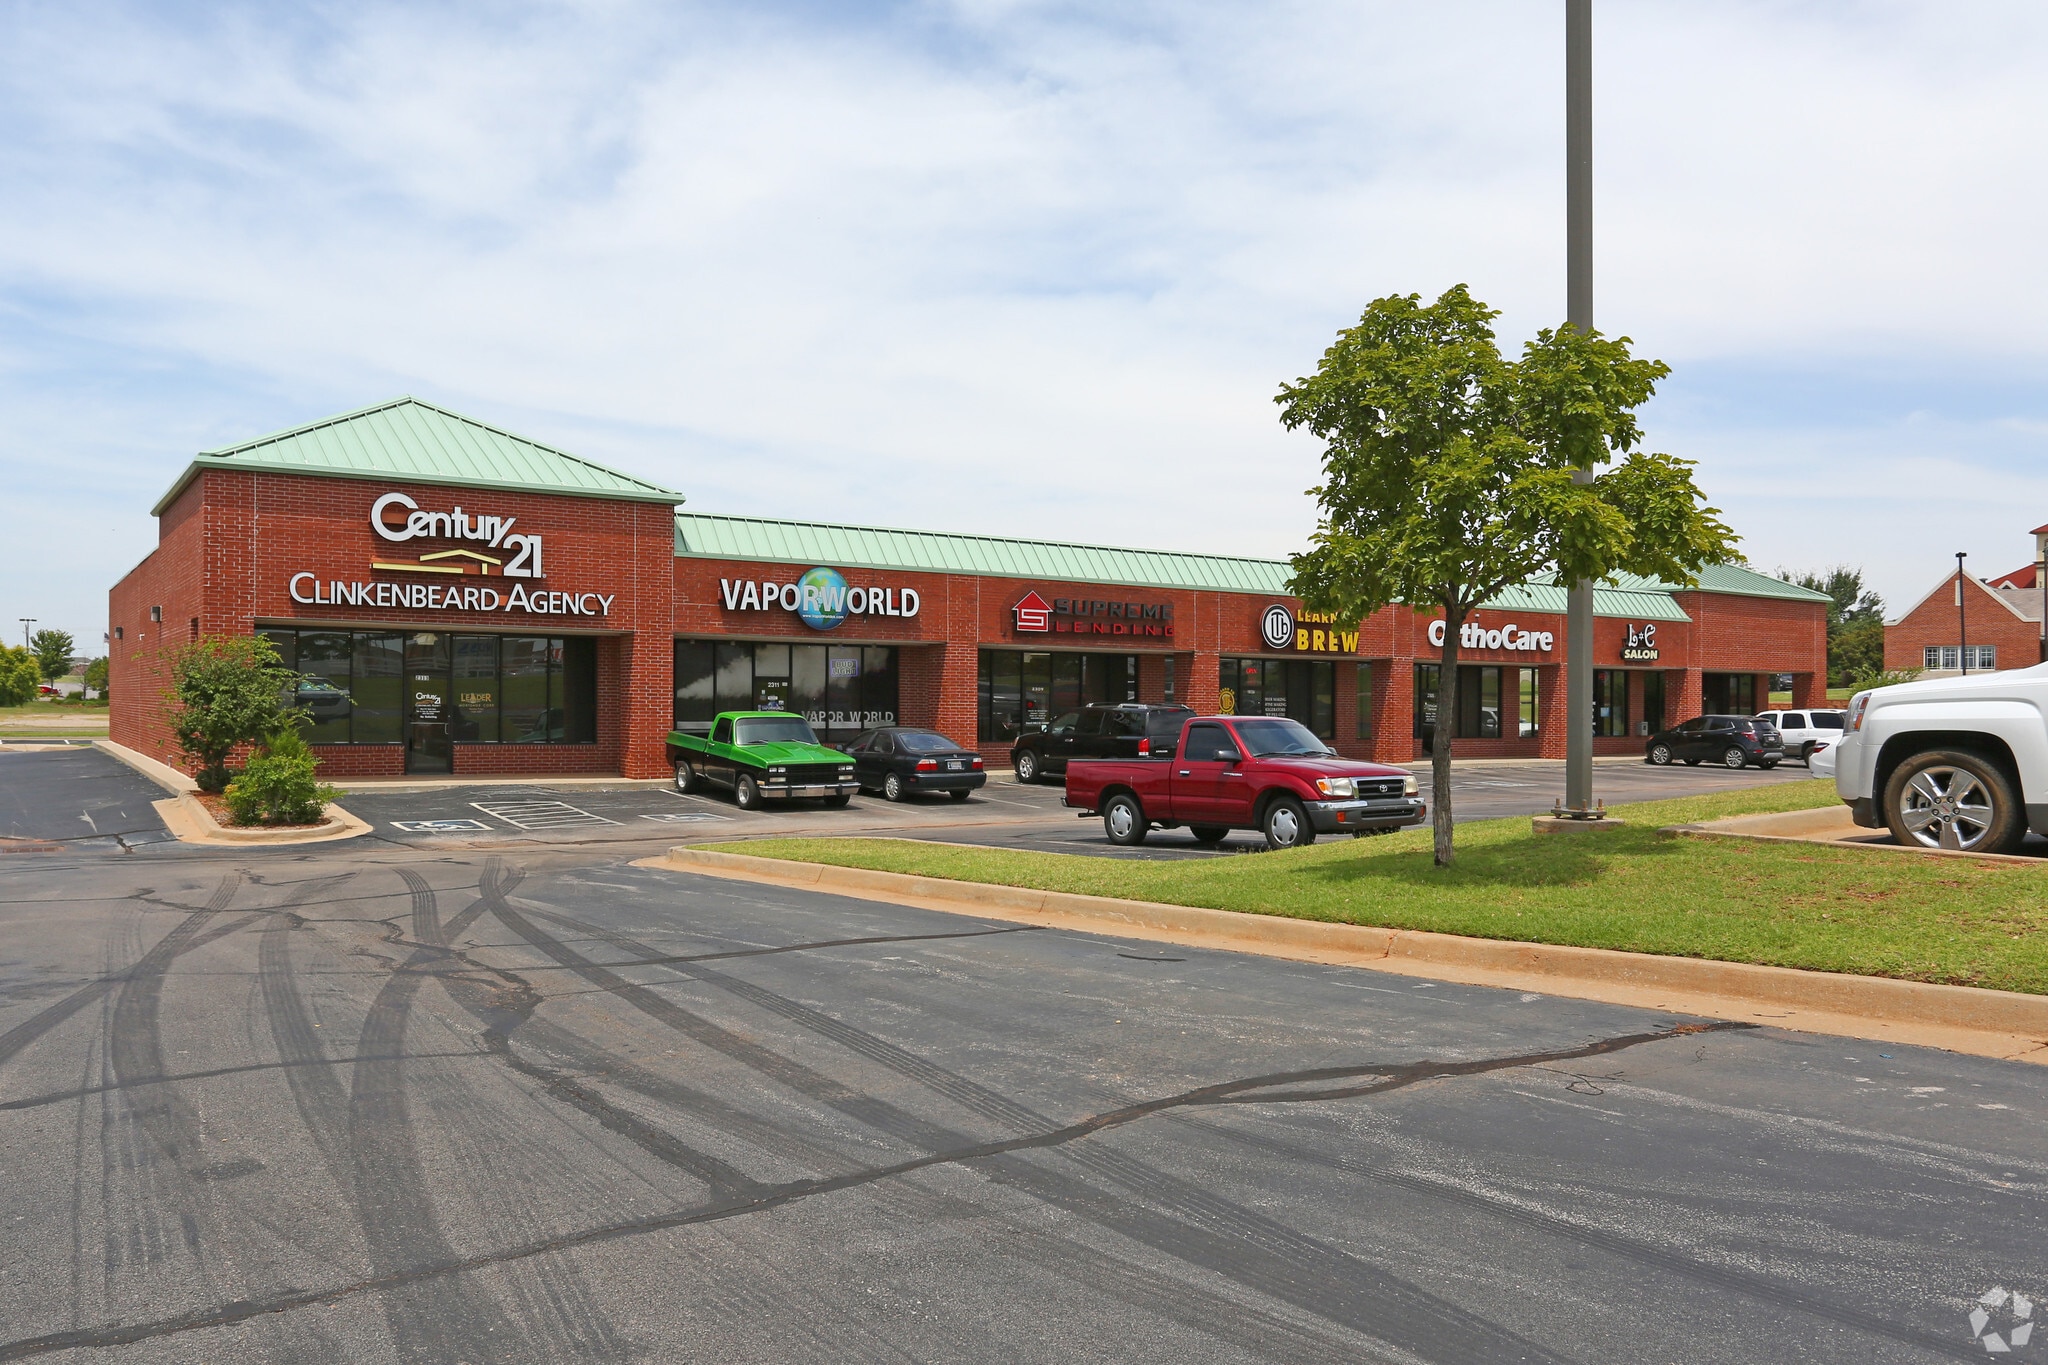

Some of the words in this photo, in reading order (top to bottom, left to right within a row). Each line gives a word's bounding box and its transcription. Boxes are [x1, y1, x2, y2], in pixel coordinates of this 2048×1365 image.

[371, 492, 516, 548] Century
[503, 533, 543, 578] 21
[289, 572, 499, 611] CLINKENBEARD
[505, 583, 615, 616] AGENCY
[1055, 599, 1174, 620] SUPREME
[1055, 621, 1175, 637] LENDING
[1297, 628, 1360, 653] BREW
[1428, 619, 1553, 652] OthoCare
[1624, 649, 1658, 660] SALON
[460, 693, 492, 702] LEADER
